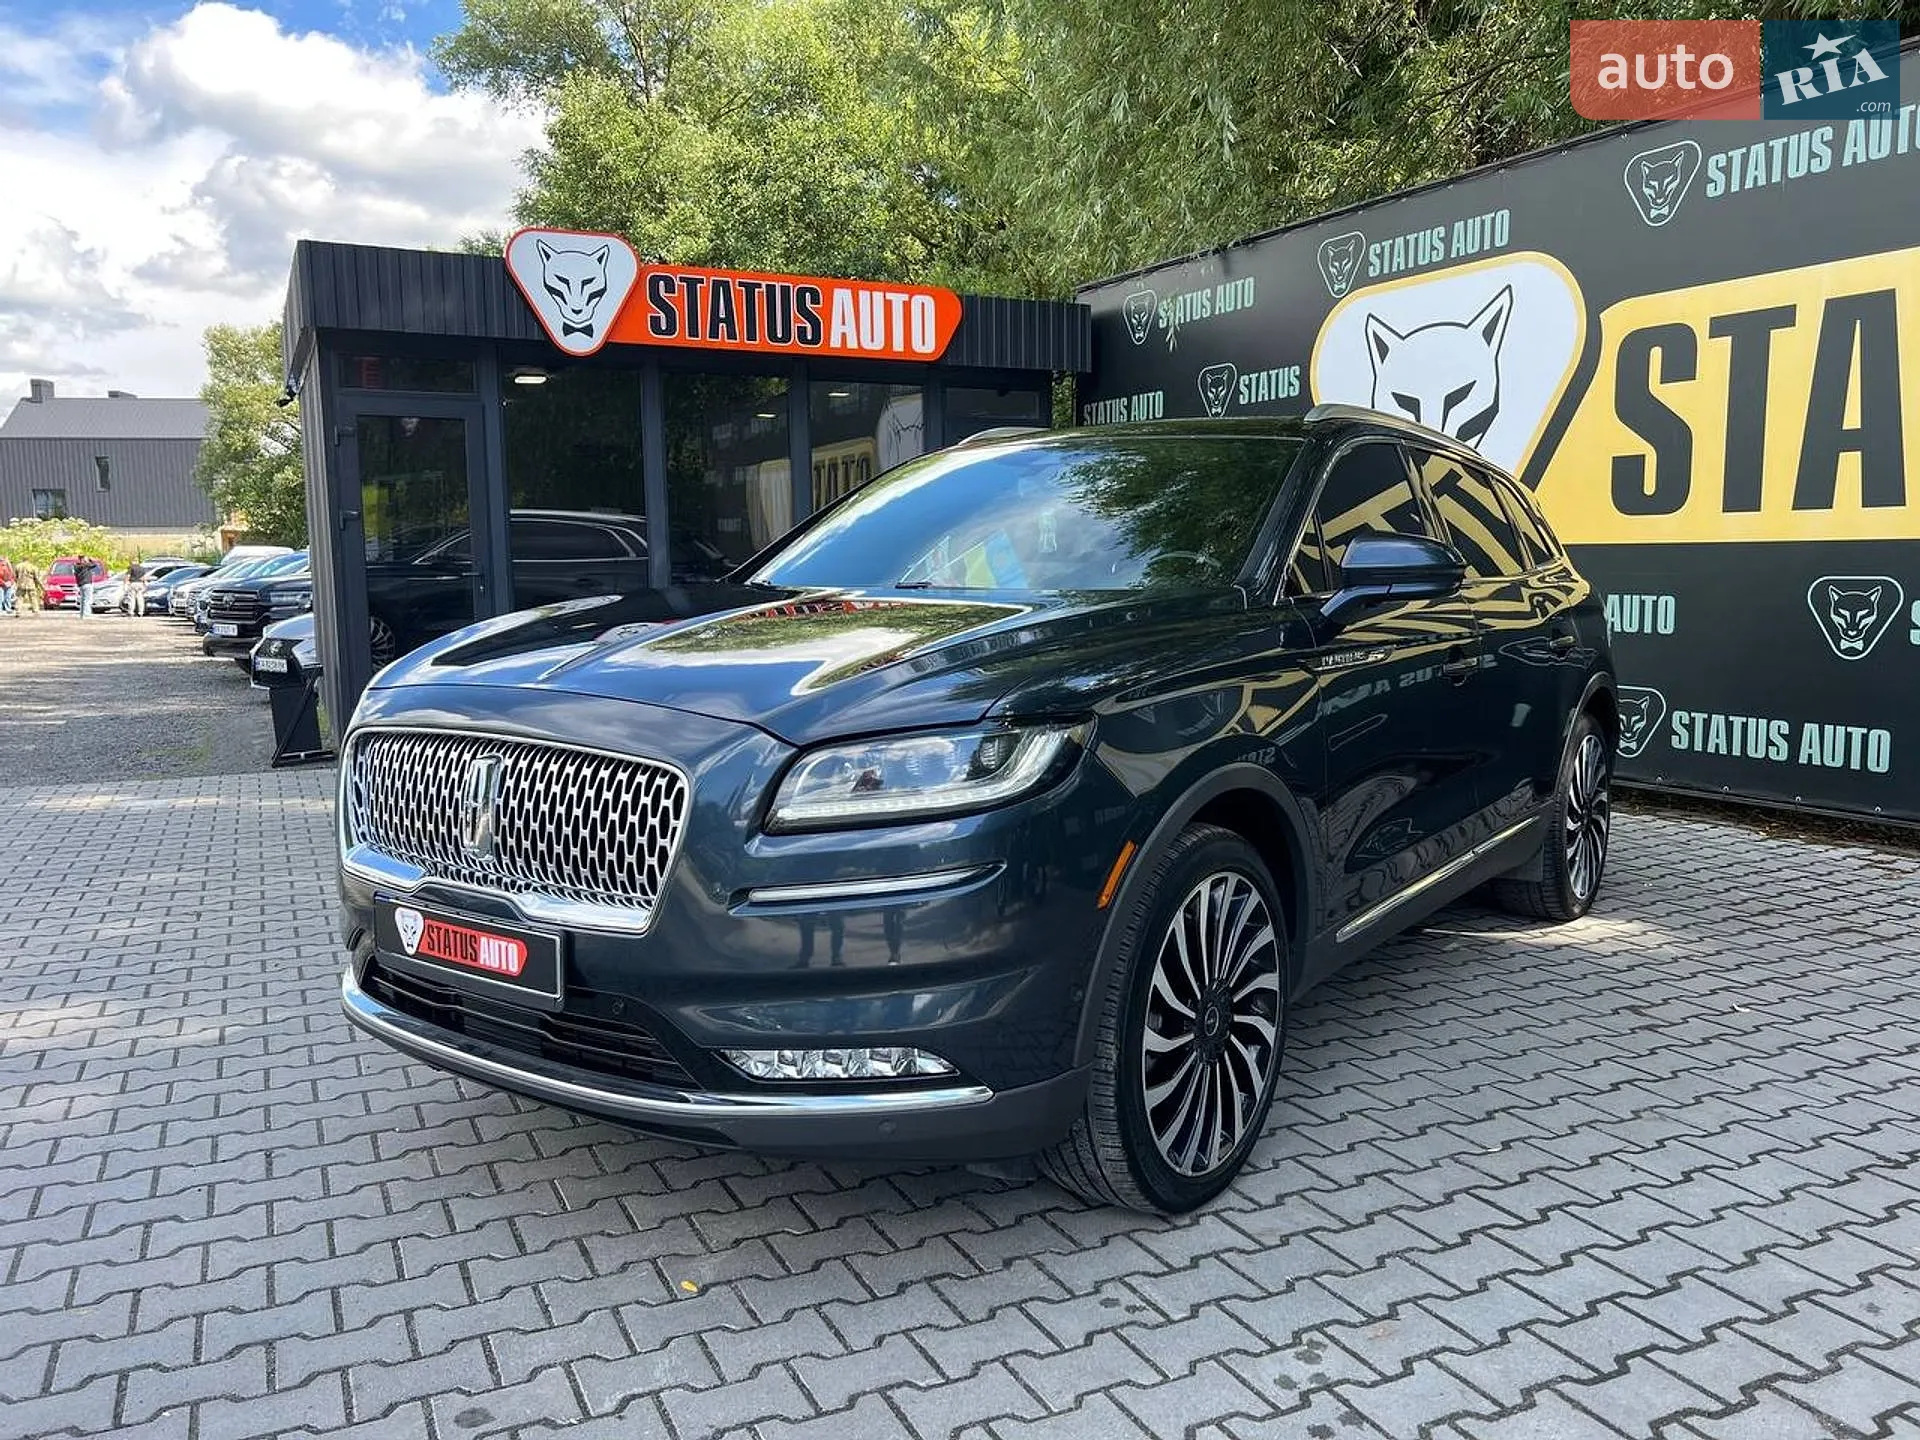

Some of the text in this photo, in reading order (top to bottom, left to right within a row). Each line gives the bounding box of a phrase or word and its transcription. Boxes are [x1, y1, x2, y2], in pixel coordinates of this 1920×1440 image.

[1706, 126, 1833, 198] STATUS
[1368, 209, 1510, 277] STATUS AUTO
[647, 272, 936, 354] STATUS AUTO
[1215, 276, 1255, 315] AUTO
[1083, 391, 1164, 426] STATUS AUTO
[1239, 366, 1300, 405] STATUS
[1610, 287, 1907, 516] STA
[1607, 594, 1675, 634] AUTO
[1671, 710, 1891, 774] STATUS AUTO
[426, 924, 519, 973] STATUS AUTO
